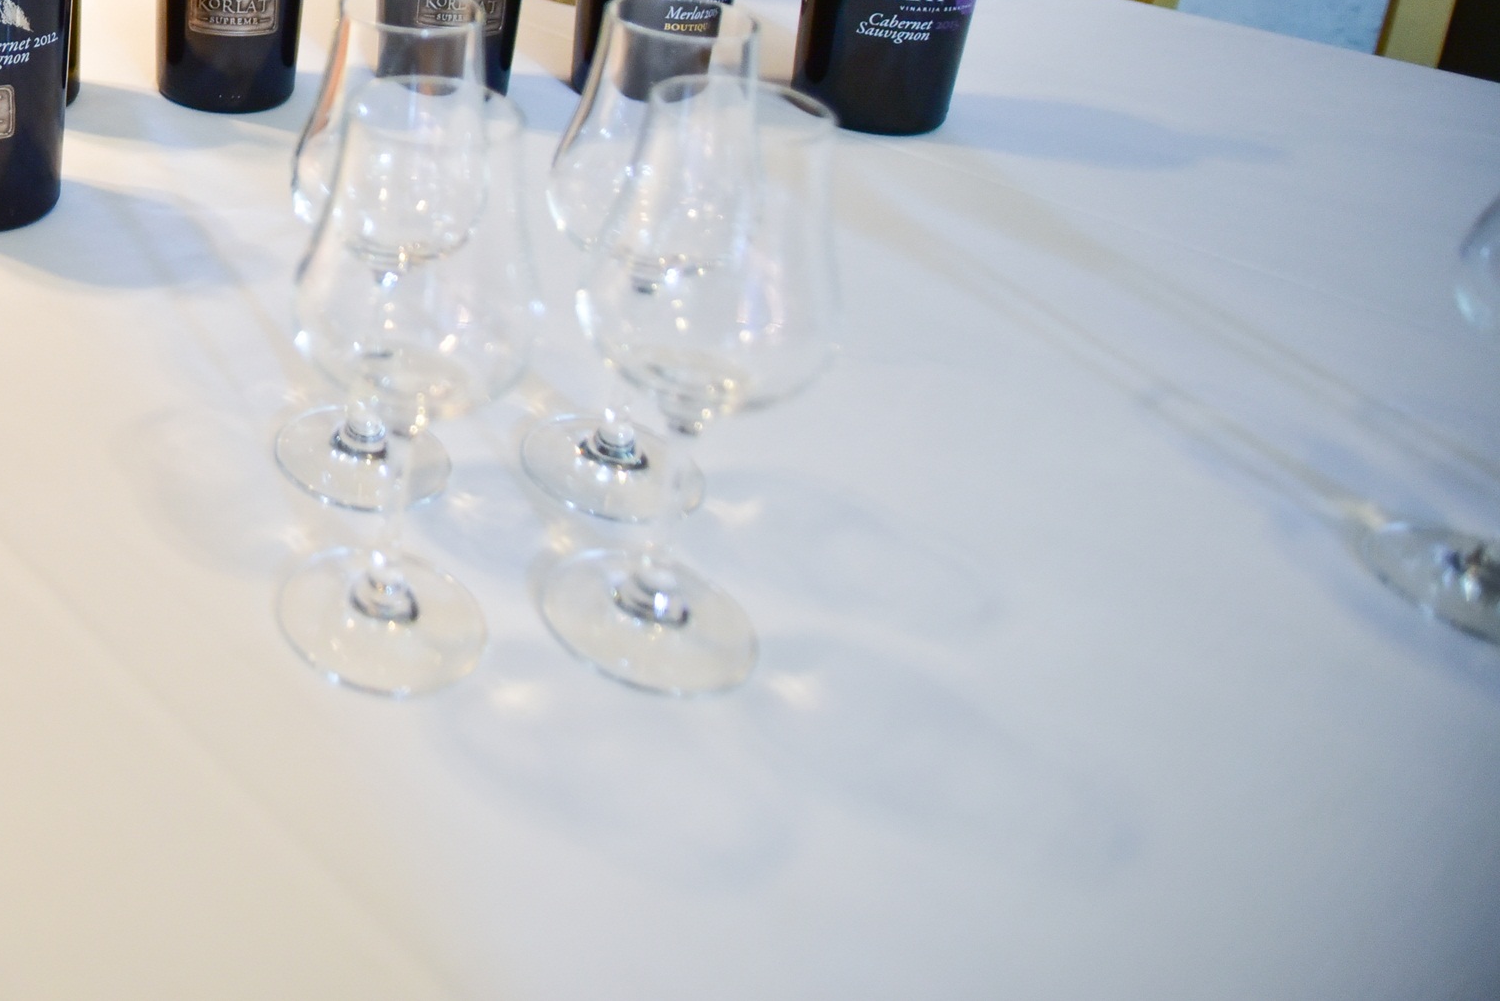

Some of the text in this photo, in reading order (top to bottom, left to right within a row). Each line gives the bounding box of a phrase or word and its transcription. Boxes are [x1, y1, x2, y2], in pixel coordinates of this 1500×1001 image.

[664, 5, 705, 21] Merlot
[900, 5, 940, 13] VINARIJA
[209, 16, 259, 26] SUPREME
[868, 12, 933, 30] Cabernet
[856, 20, 931, 45] Sauvignon
